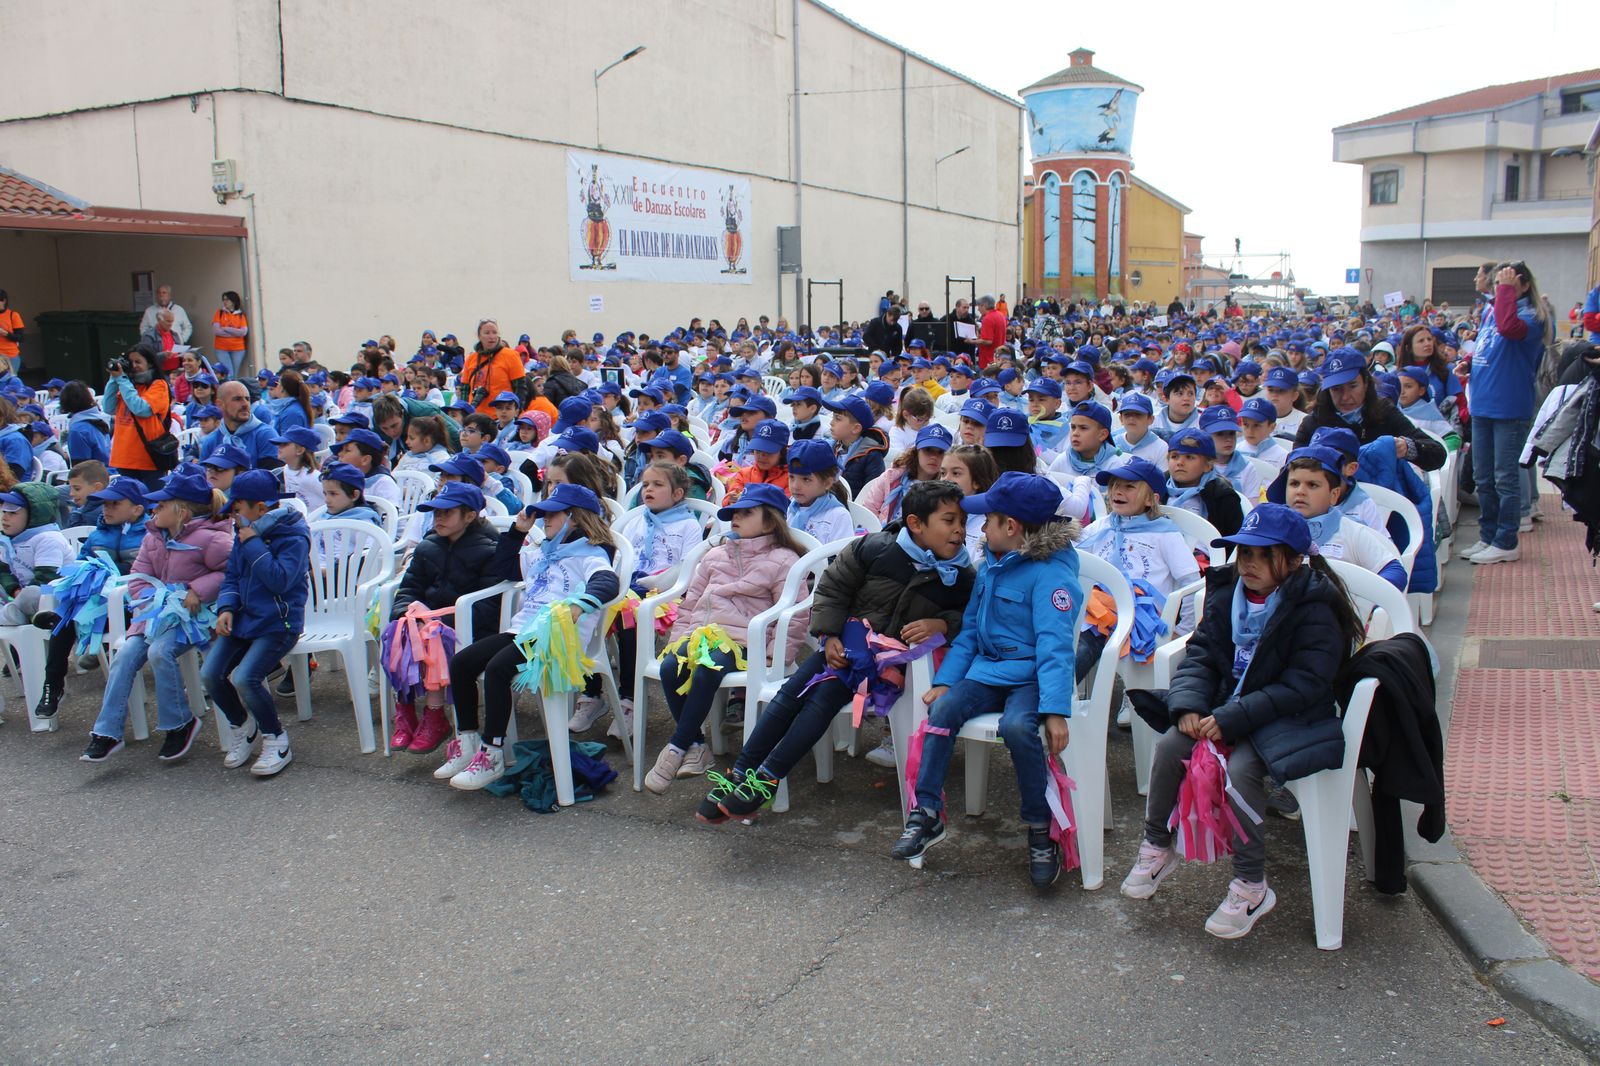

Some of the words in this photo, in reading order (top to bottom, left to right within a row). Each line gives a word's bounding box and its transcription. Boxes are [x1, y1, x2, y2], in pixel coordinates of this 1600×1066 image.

[632, 176, 706, 200] Encuentro
[633, 197, 643, 212] de
[645, 198, 672, 215] Danzas
[674, 201, 706, 219] Escolares
[619, 229, 629, 256] EL
[631, 230, 659, 257] DANZAR
[661, 232, 670, 258] DE
[672, 233, 684, 258] LOS
[686, 234, 718, 260] DANZARES
